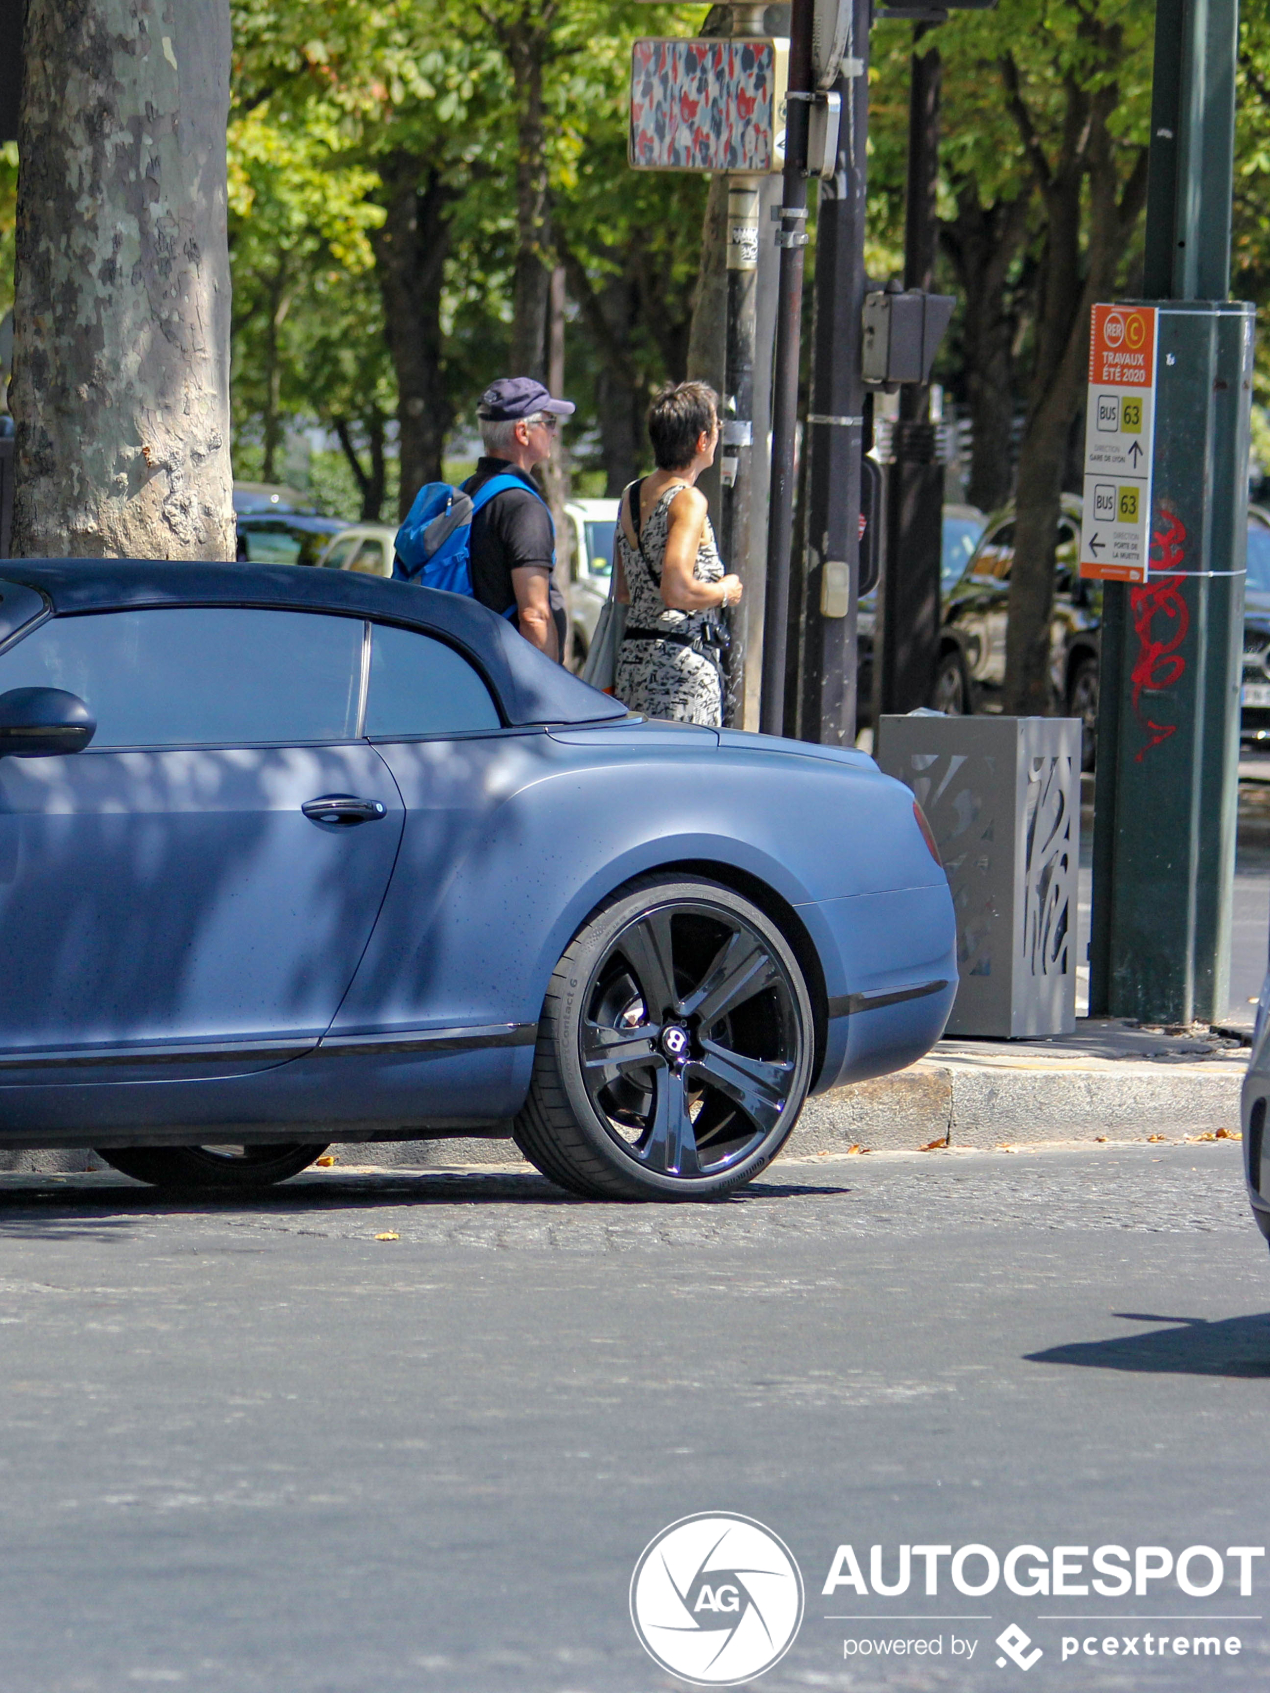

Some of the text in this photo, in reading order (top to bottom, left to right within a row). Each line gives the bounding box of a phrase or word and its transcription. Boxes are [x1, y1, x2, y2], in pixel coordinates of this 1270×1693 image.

[1106, 322, 1139, 341] RER C
[1102, 352, 1145, 366] TRAVAUX
[1102, 363, 1146, 383] ÉTÉ 2020
[1100, 405, 1140, 425] BUS 63
[1094, 444, 1120, 453] DIRECTION
[1089, 454, 1103, 462] GARE
[1112, 455, 1126, 463] LYON
[1096, 494, 1137, 514] BUS 63
[1113, 531, 1140, 540] DIRECTION
[1114, 542, 1138, 551] PORTE DE
